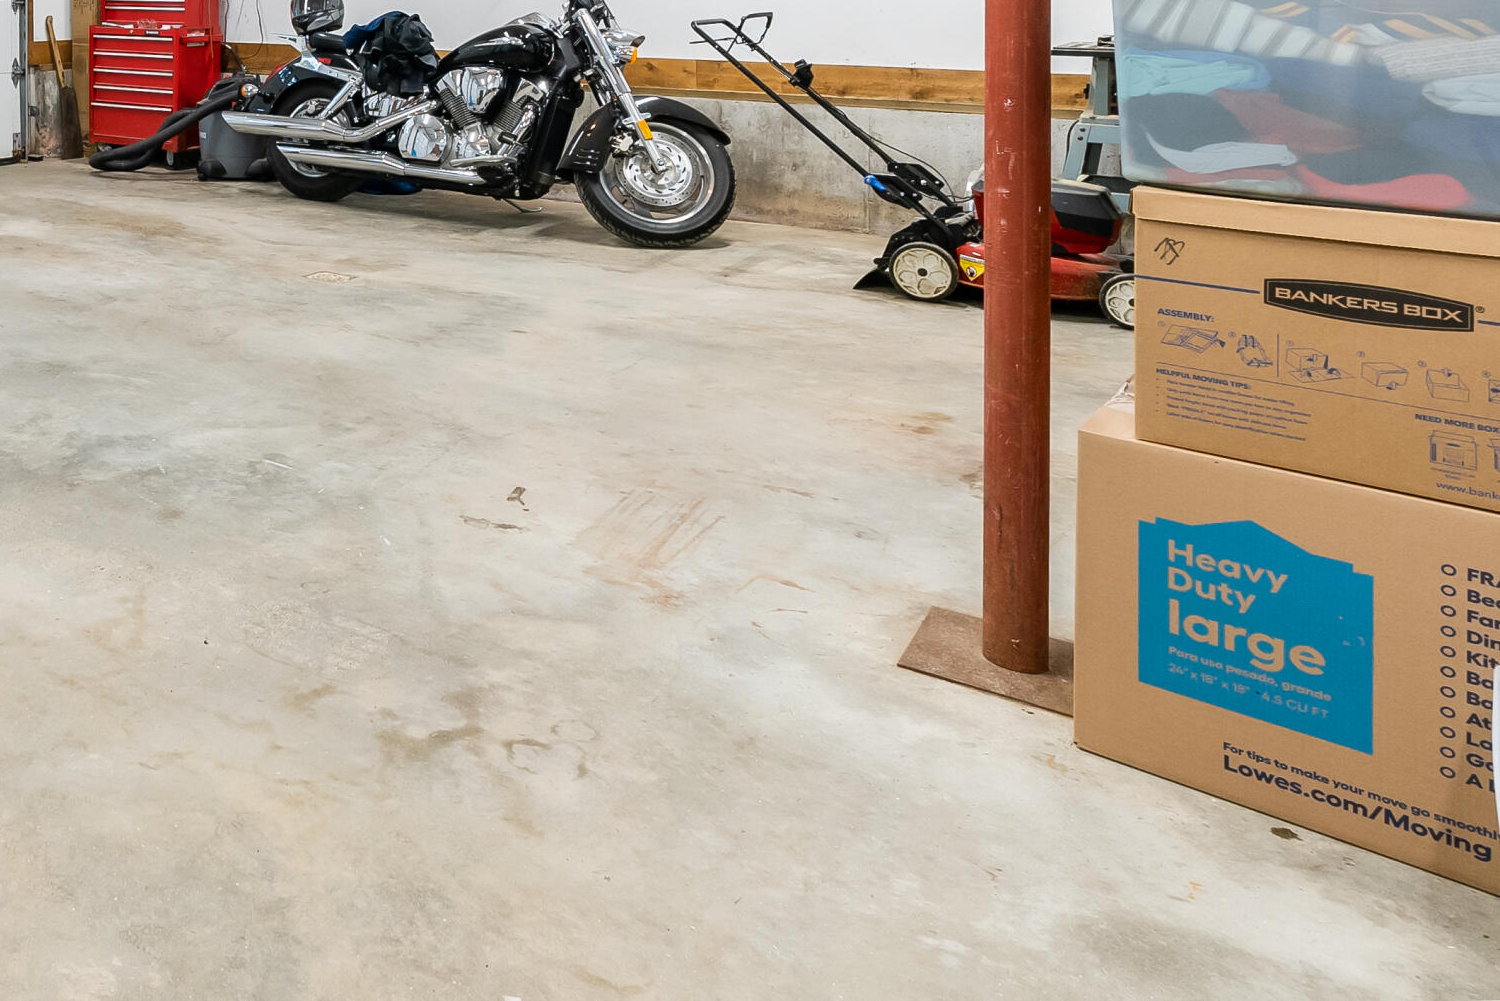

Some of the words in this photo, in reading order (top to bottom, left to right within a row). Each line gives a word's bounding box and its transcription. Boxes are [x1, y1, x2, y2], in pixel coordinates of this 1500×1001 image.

[1157, 308, 1215, 323] ASSEMBLY:
[1275, 287, 1398, 314] BANKERS
[1403, 303, 1464, 323] BOX
[1156, 368, 1192, 380] HELPFUL
[1192, 373, 1229, 386] MOVING
[1415, 413, 1442, 424] NEED
[1444, 418, 1475, 430] MORE
[1167, 539, 1289, 593] Heavy
[1167, 566, 1256, 614] Duty
[1168, 599, 1327, 676] large
[1168, 646, 1198, 662] Para
[1201, 657, 1224, 669] uso
[1225, 664, 1279, 688] pesado,
[1281, 681, 1332, 702] grande
[1286, 699, 1308, 713] CU
[1311, 706, 1329, 719] FT
[1223, 741, 1245, 757] For
[1247, 749, 1272, 766] tips
[1274, 758, 1288, 771] to
[1291, 765, 1330, 785] make
[1332, 779, 1365, 796] your
[1368, 791, 1407, 810] move
[1411, 805, 1430, 818] go
[1465, 773, 1483, 789] A
[1223, 754, 1492, 863] Lowes.com/Moving
